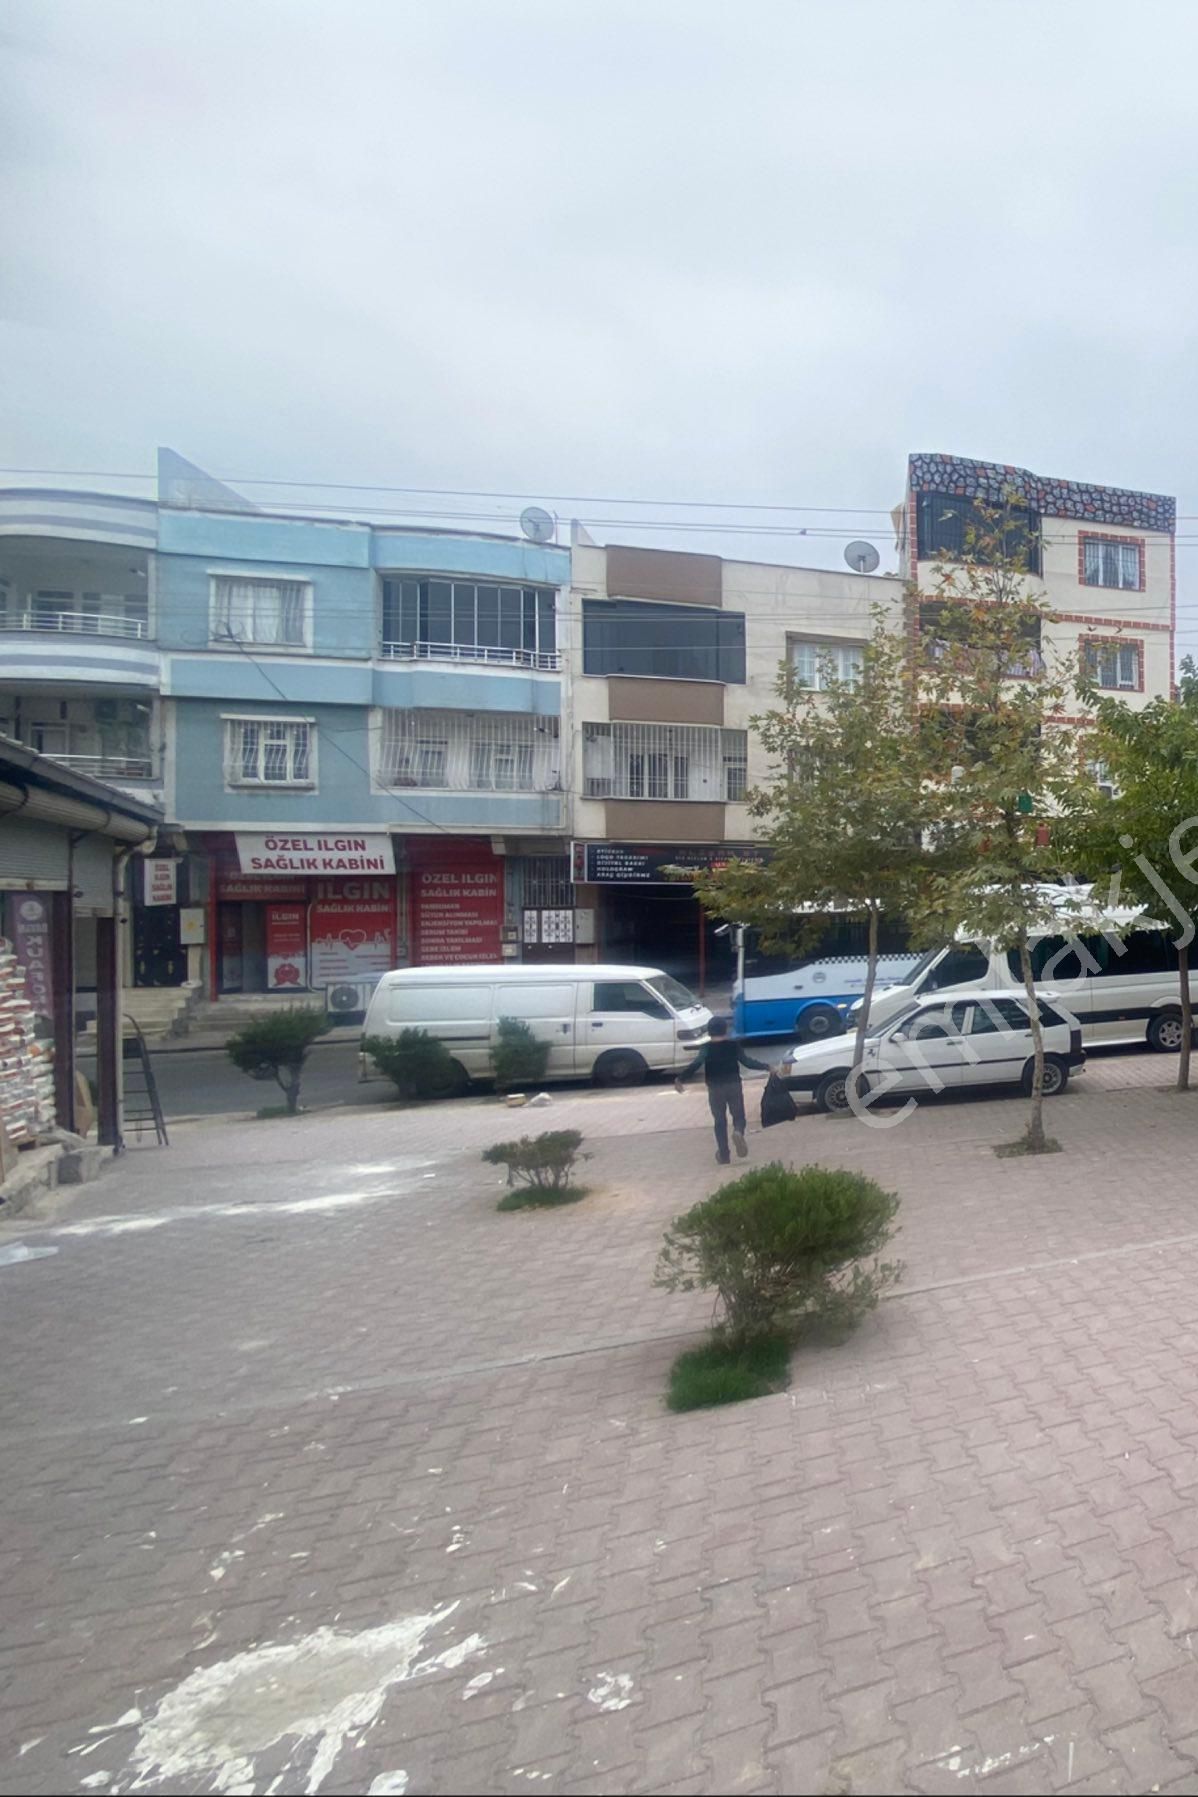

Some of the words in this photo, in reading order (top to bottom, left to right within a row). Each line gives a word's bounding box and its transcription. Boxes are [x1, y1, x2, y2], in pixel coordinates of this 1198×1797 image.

[265, 837, 314, 851] ÖZEL
[318, 839, 366, 851] ILGIN
[251, 855, 318, 870] SAĞLIK
[323, 855, 385, 870] KABİNİ
[421, 887, 460, 897] SAĞLIK
